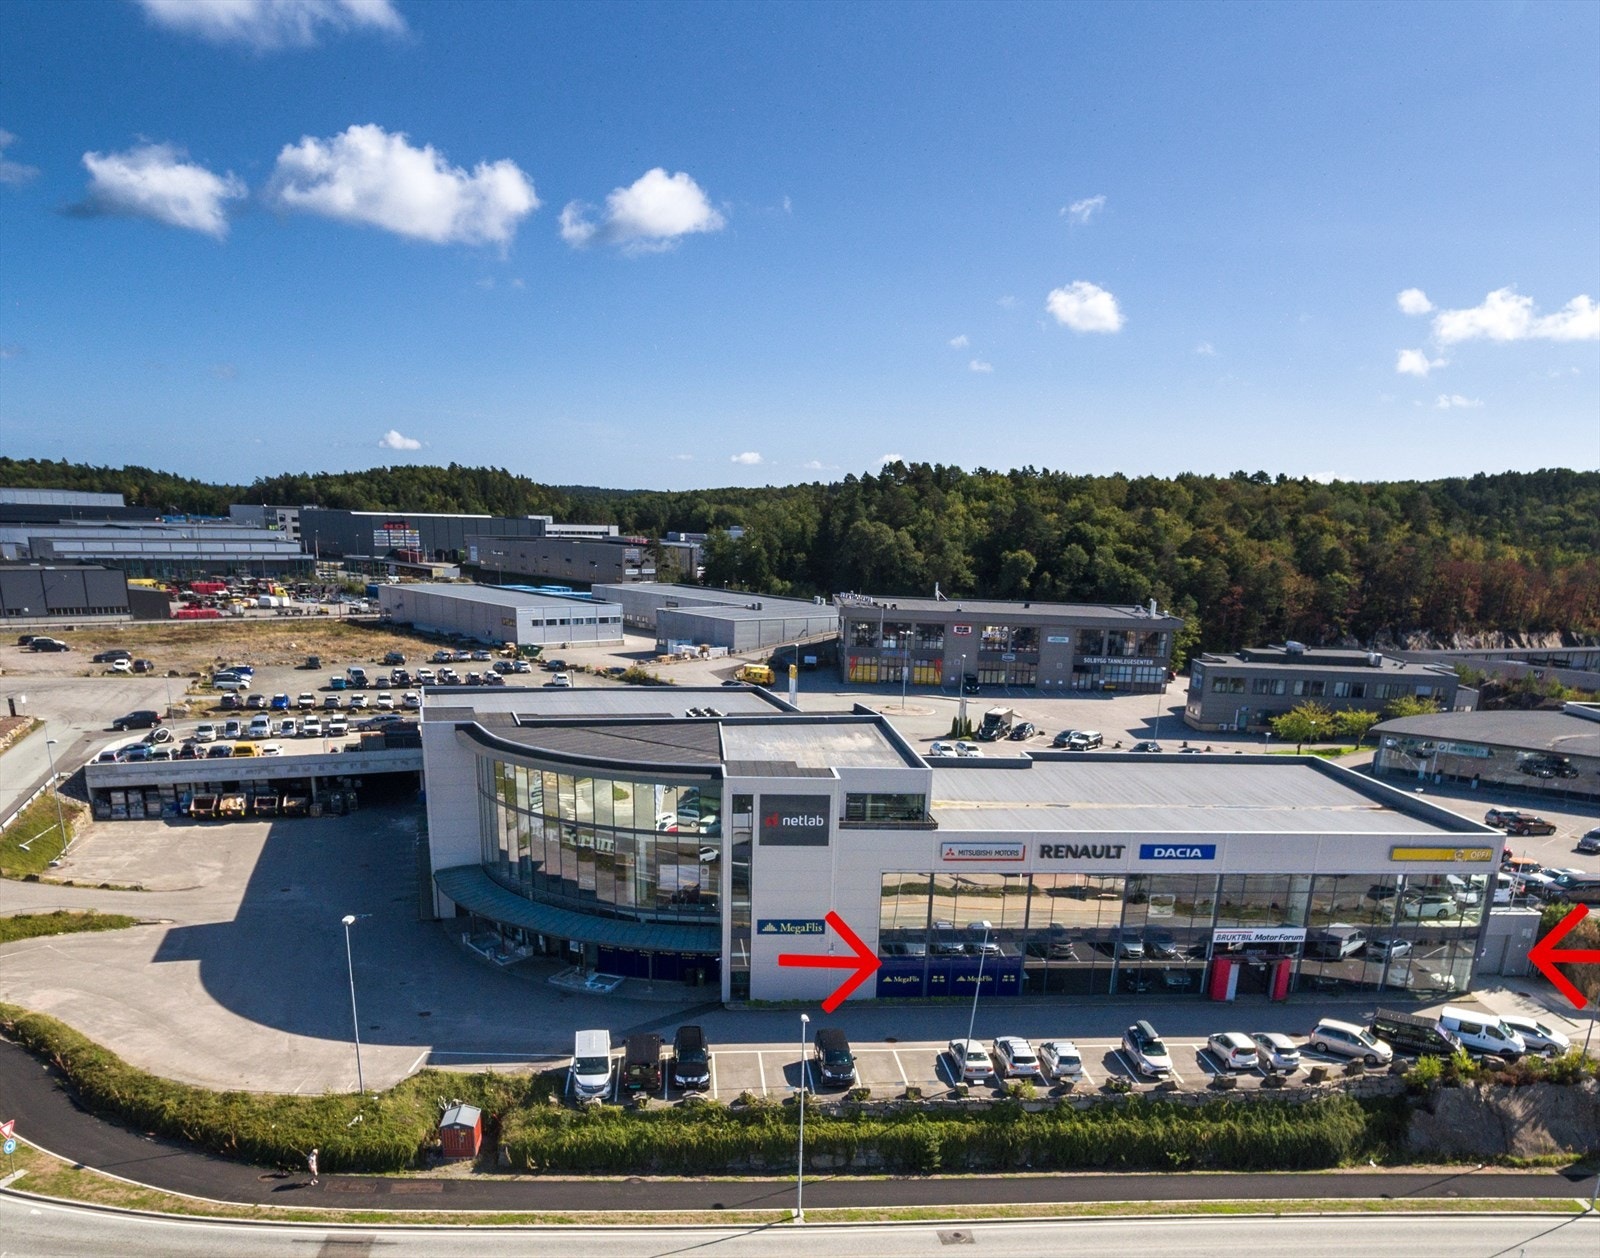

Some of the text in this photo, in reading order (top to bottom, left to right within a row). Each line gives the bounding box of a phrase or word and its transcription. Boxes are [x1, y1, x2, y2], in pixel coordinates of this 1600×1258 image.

[1107, 658, 1154, 666] TANNLEGESENTER
[782, 814, 824, 826] netlab
[958, 849, 1020, 857] MITSUBISHI MOTORS
[1039, 844, 1126, 859] RENAULT
[1153, 847, 1202, 858] DACIA
[780, 922, 823, 935] MegaFlis
[893, 976, 920, 984] MegaFlis
